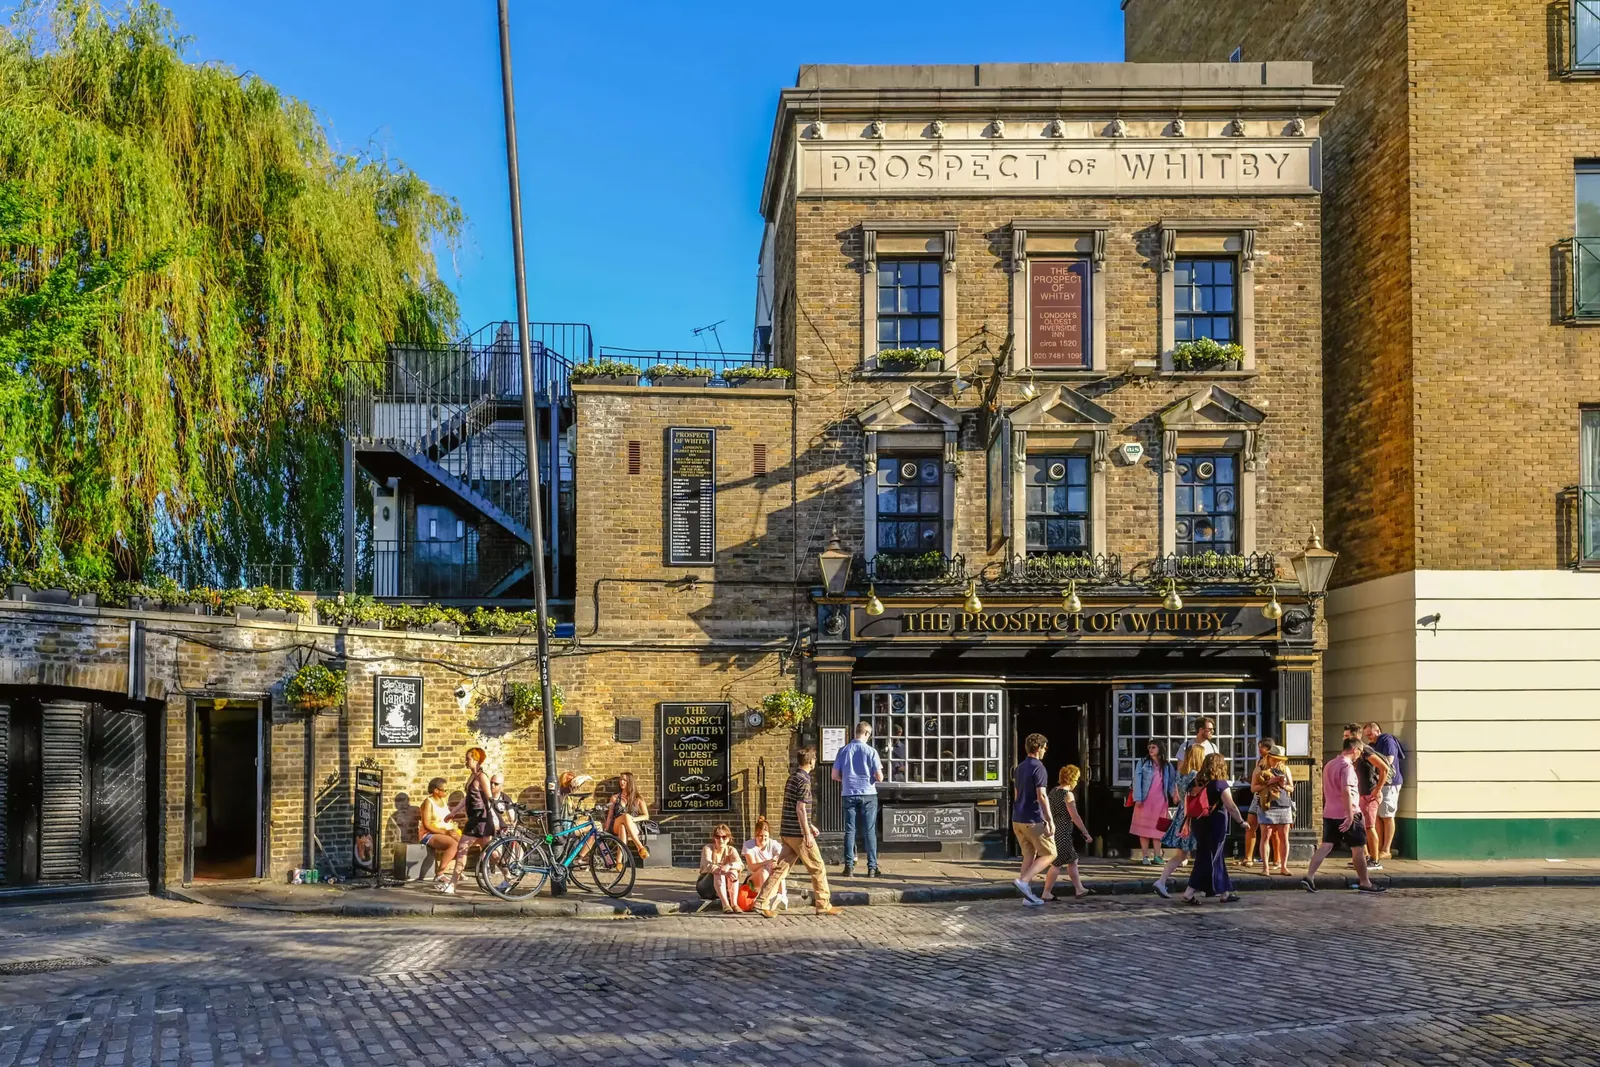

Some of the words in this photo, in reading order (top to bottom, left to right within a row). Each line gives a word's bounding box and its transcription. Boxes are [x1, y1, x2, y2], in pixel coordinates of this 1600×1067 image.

[830, 153, 1048, 183] PROSPECT
[1067, 158, 1098, 177] OF
[1122, 153, 1291, 181] WHITBY
[1050, 267, 1069, 275] THE
[1033, 275, 1083, 283] PROSPECT
[1051, 284, 1065, 292] OF
[1040, 292, 1076, 300] WHITBY
[903, 611, 952, 632] THE
[960, 611, 1085, 632] PROSPECT
[1091, 612, 1122, 632] OF
[1130, 612, 1228, 632] WHITBY
[684, 706, 707, 715] THE
[668, 716, 723, 725] PROSPECT
[665, 726, 680, 735] OF
[682, 726, 726, 735] WHITBY
[673, 743, 718, 751] LONDON'S
[679, 751, 713, 759] OLDEST
[673, 759, 718, 767] RIVERSIDE
[688, 767, 703, 775] INN
[668, 783, 695, 792] Circa
[699, 783, 723, 792] 1520
[668, 800, 682, 808] 020
[684, 800, 702, 808] 7481
[705, 800, 724, 808] 1095
[893, 814, 926, 825] FOOD
